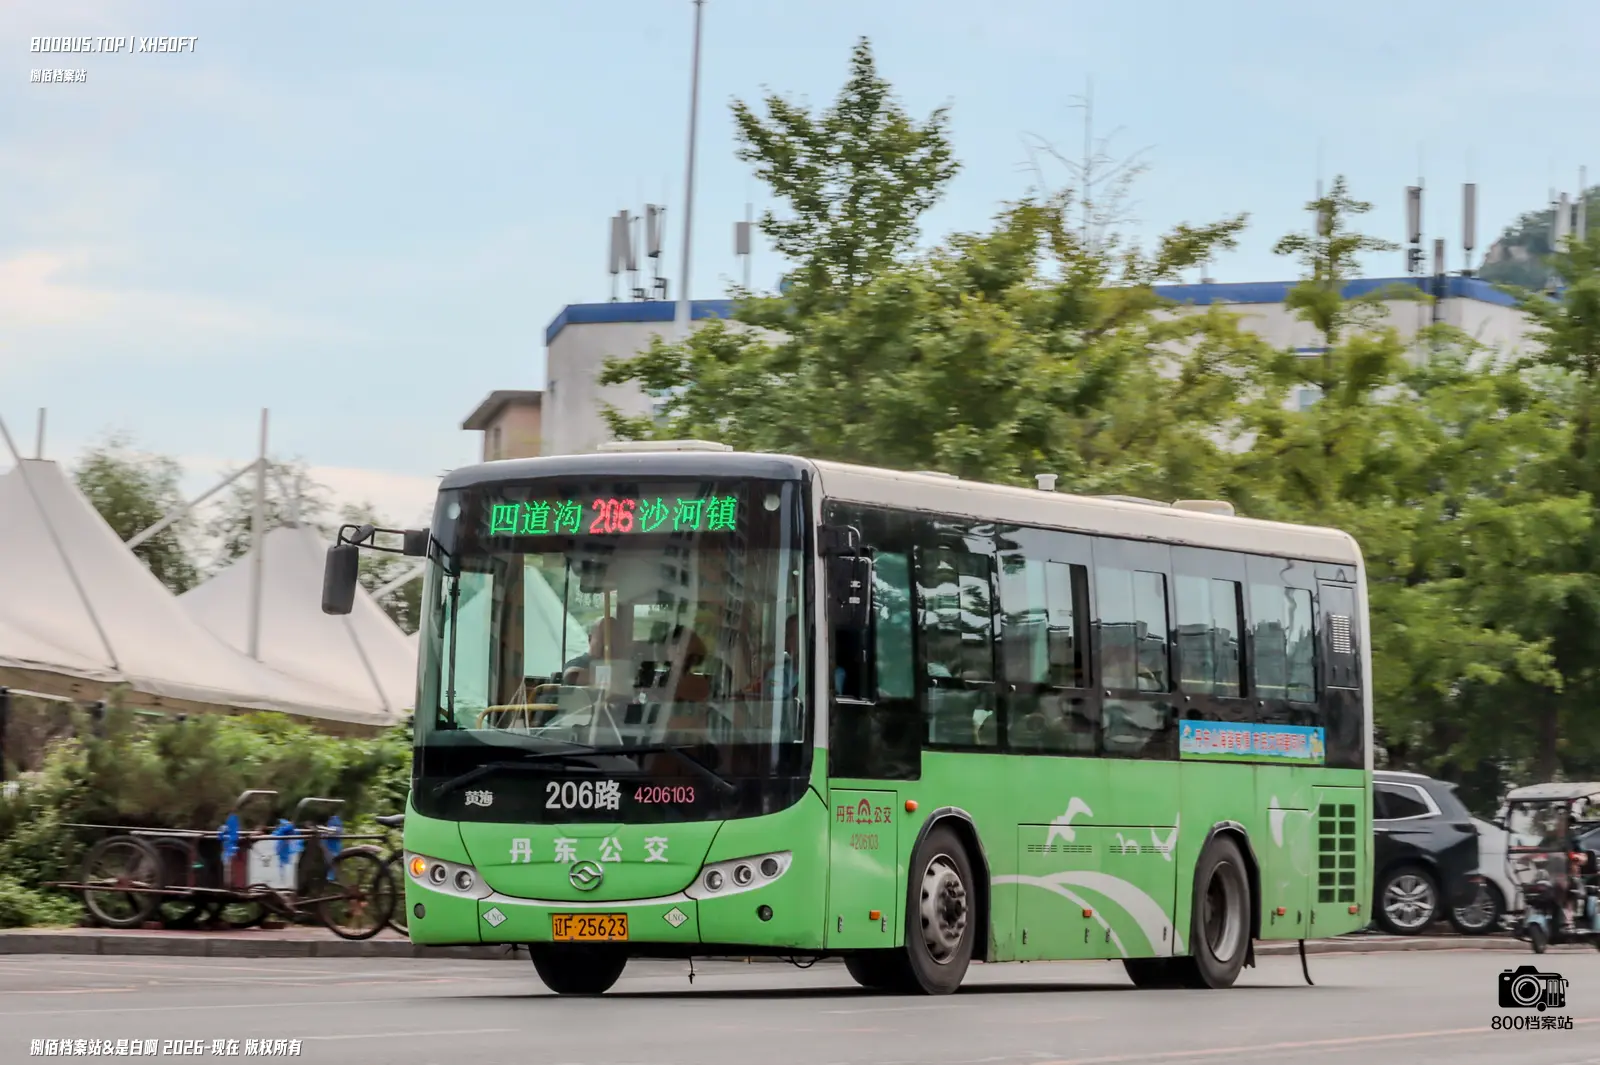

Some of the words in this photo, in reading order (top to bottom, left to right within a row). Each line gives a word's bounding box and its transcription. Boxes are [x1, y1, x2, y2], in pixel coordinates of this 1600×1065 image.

[490, 499, 582, 536] 四道沟
[589, 498, 636, 535] 206
[638, 495, 738, 533] 沙河镇
[465, 790, 493, 807] 黄海
[545, 779, 622, 811] 206路
[634, 786, 696, 804] 4206103
[509, 835, 669, 864] 丹东公交
[486, 912, 504, 923] LNG
[667, 910, 684, 923] LNG
